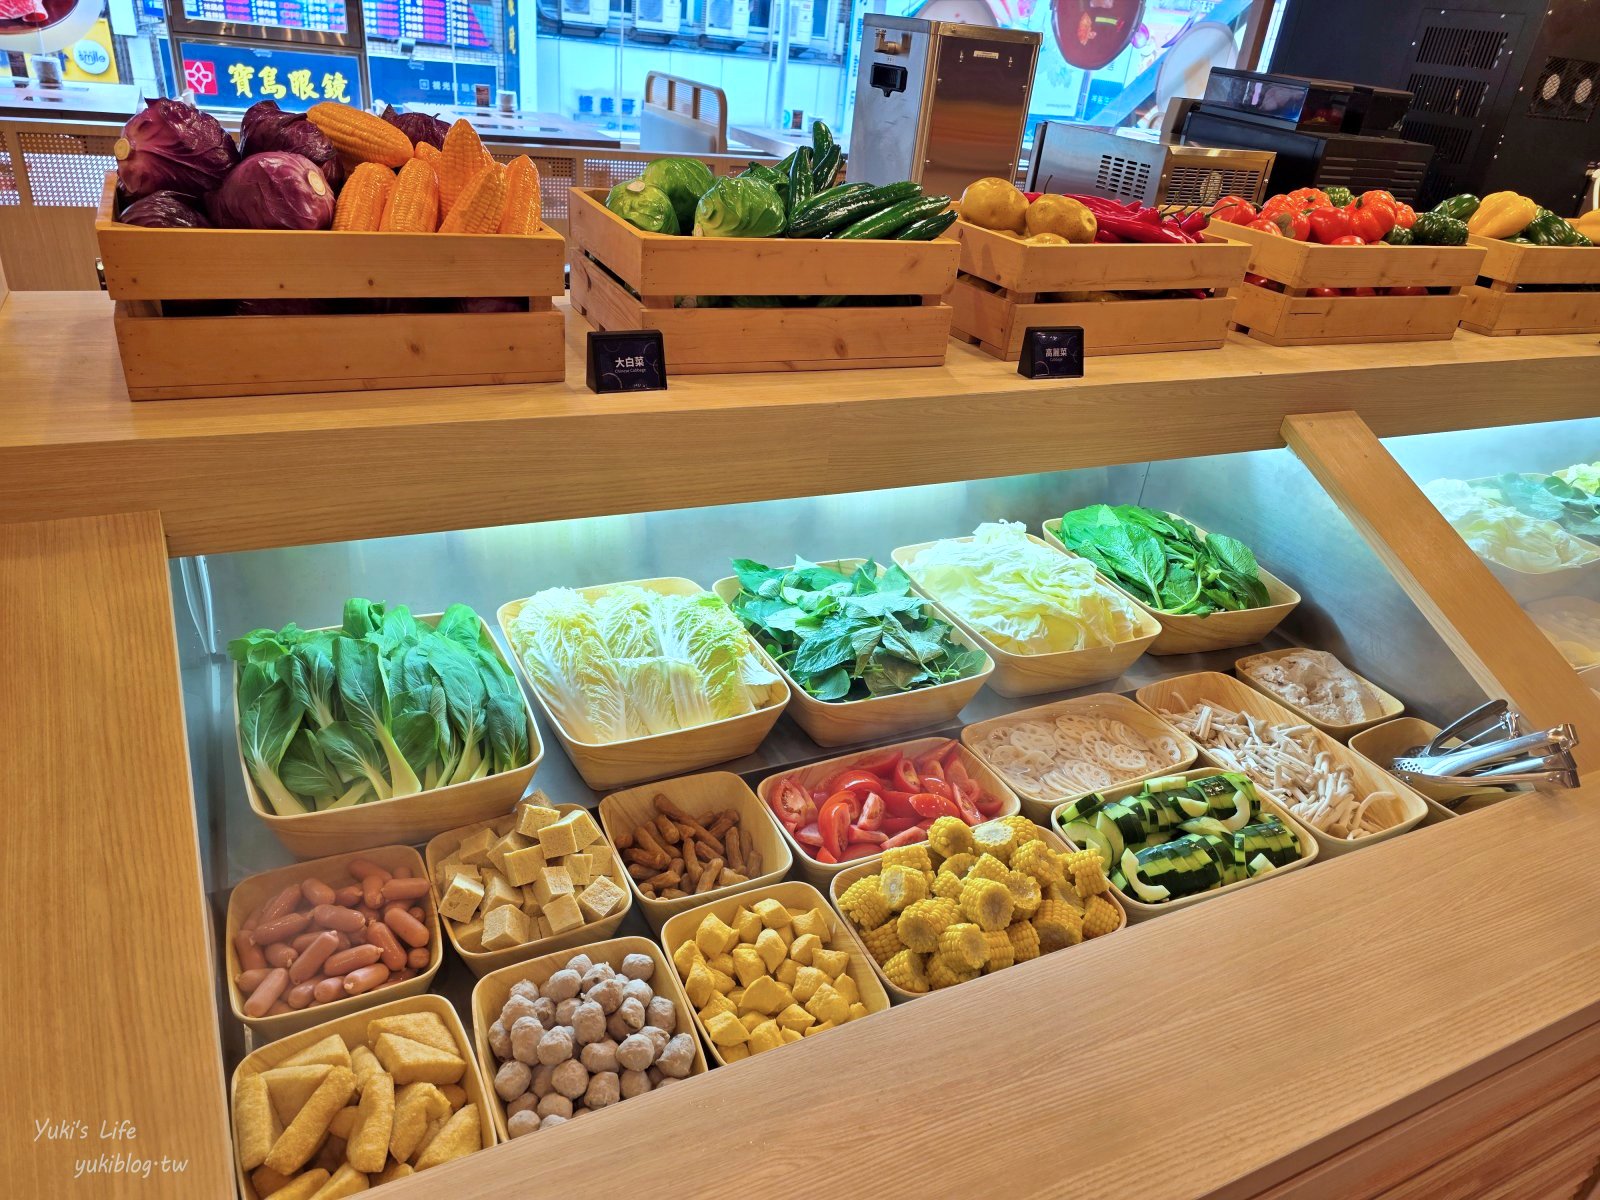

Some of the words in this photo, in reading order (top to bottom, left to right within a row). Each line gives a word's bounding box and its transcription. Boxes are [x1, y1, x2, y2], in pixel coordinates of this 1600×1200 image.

[228, 62, 351, 104] 寶島眼鏡
[1045, 347, 1068, 358] 高麗菜
[614, 356, 645, 368] 大白菜
